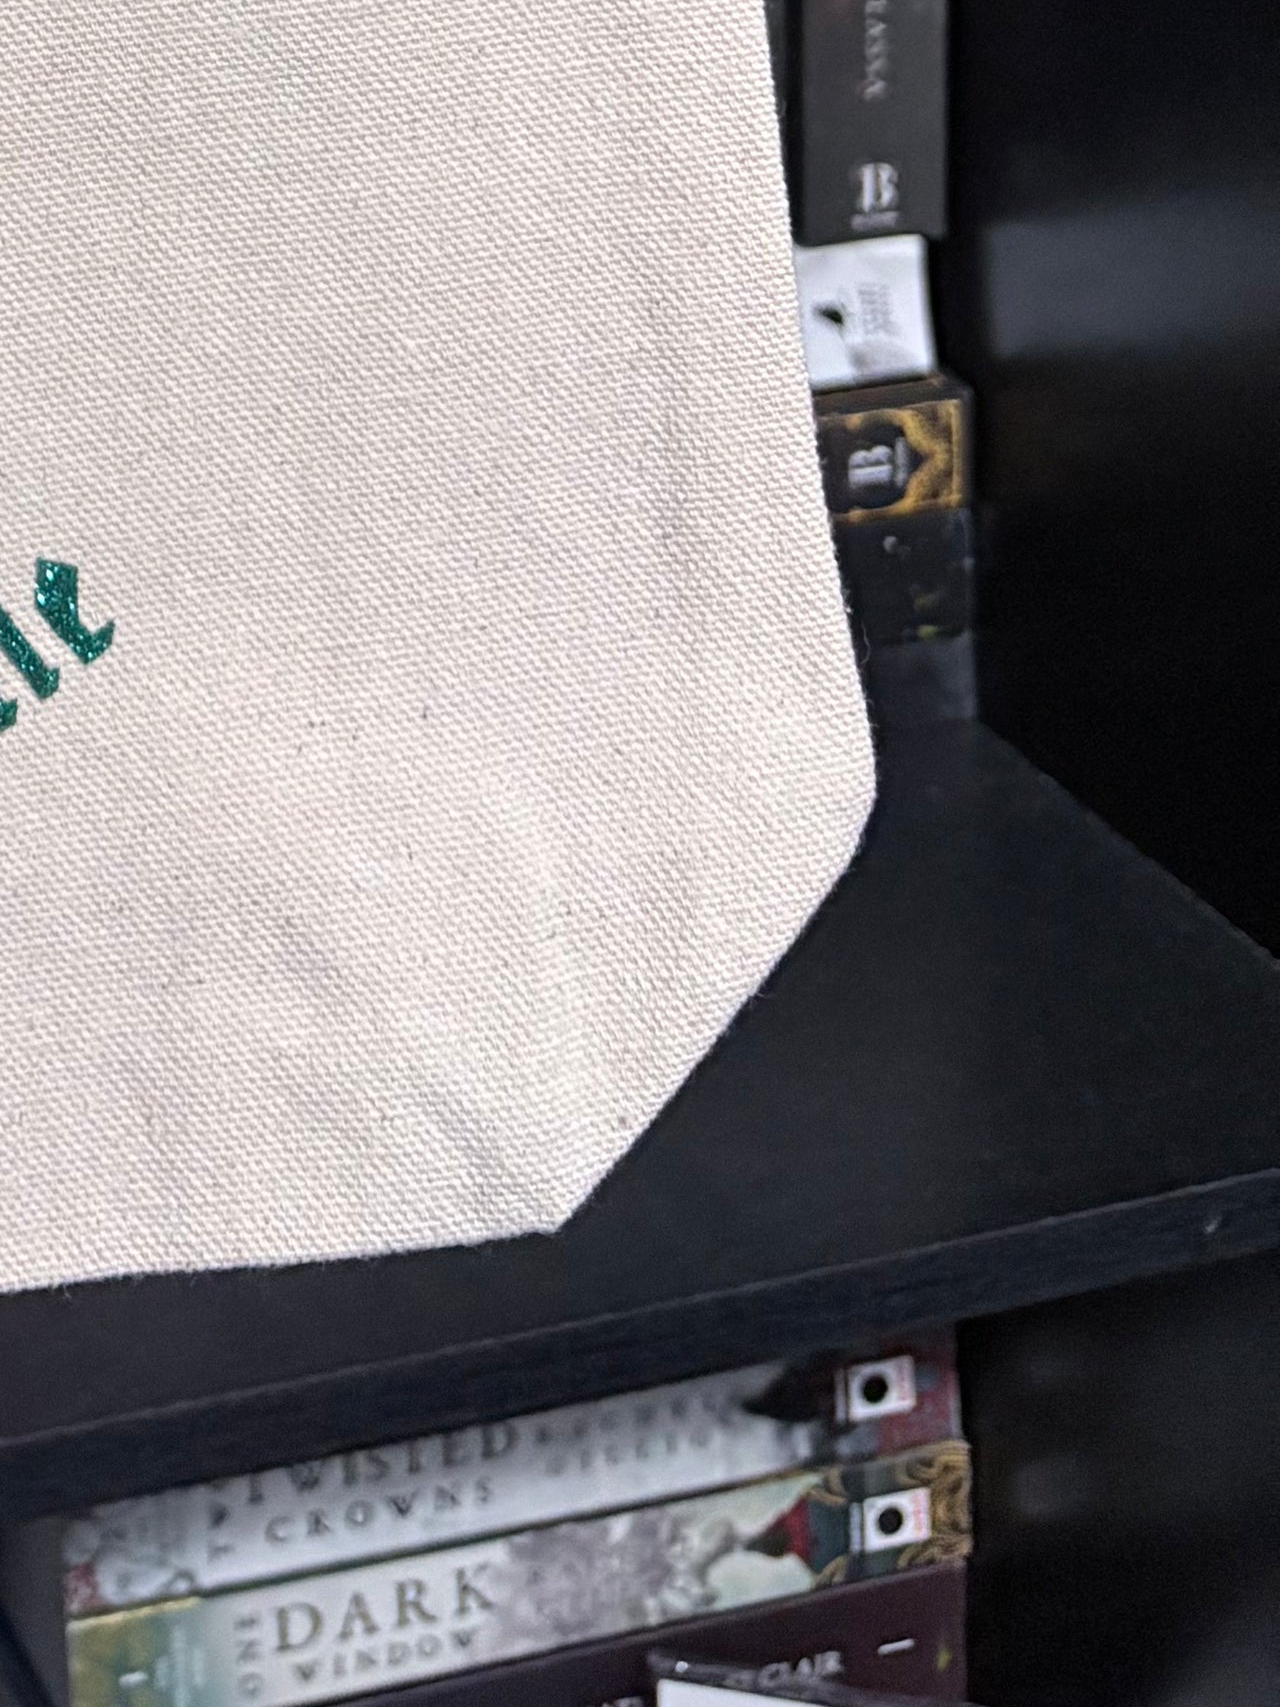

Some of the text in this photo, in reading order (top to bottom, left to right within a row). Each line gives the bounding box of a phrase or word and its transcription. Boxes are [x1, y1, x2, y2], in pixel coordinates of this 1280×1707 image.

[264, 1476, 495, 1544] CROWNS
[276, 1563, 496, 1653] DARK
[294, 1629, 477, 1682] WINDOW
